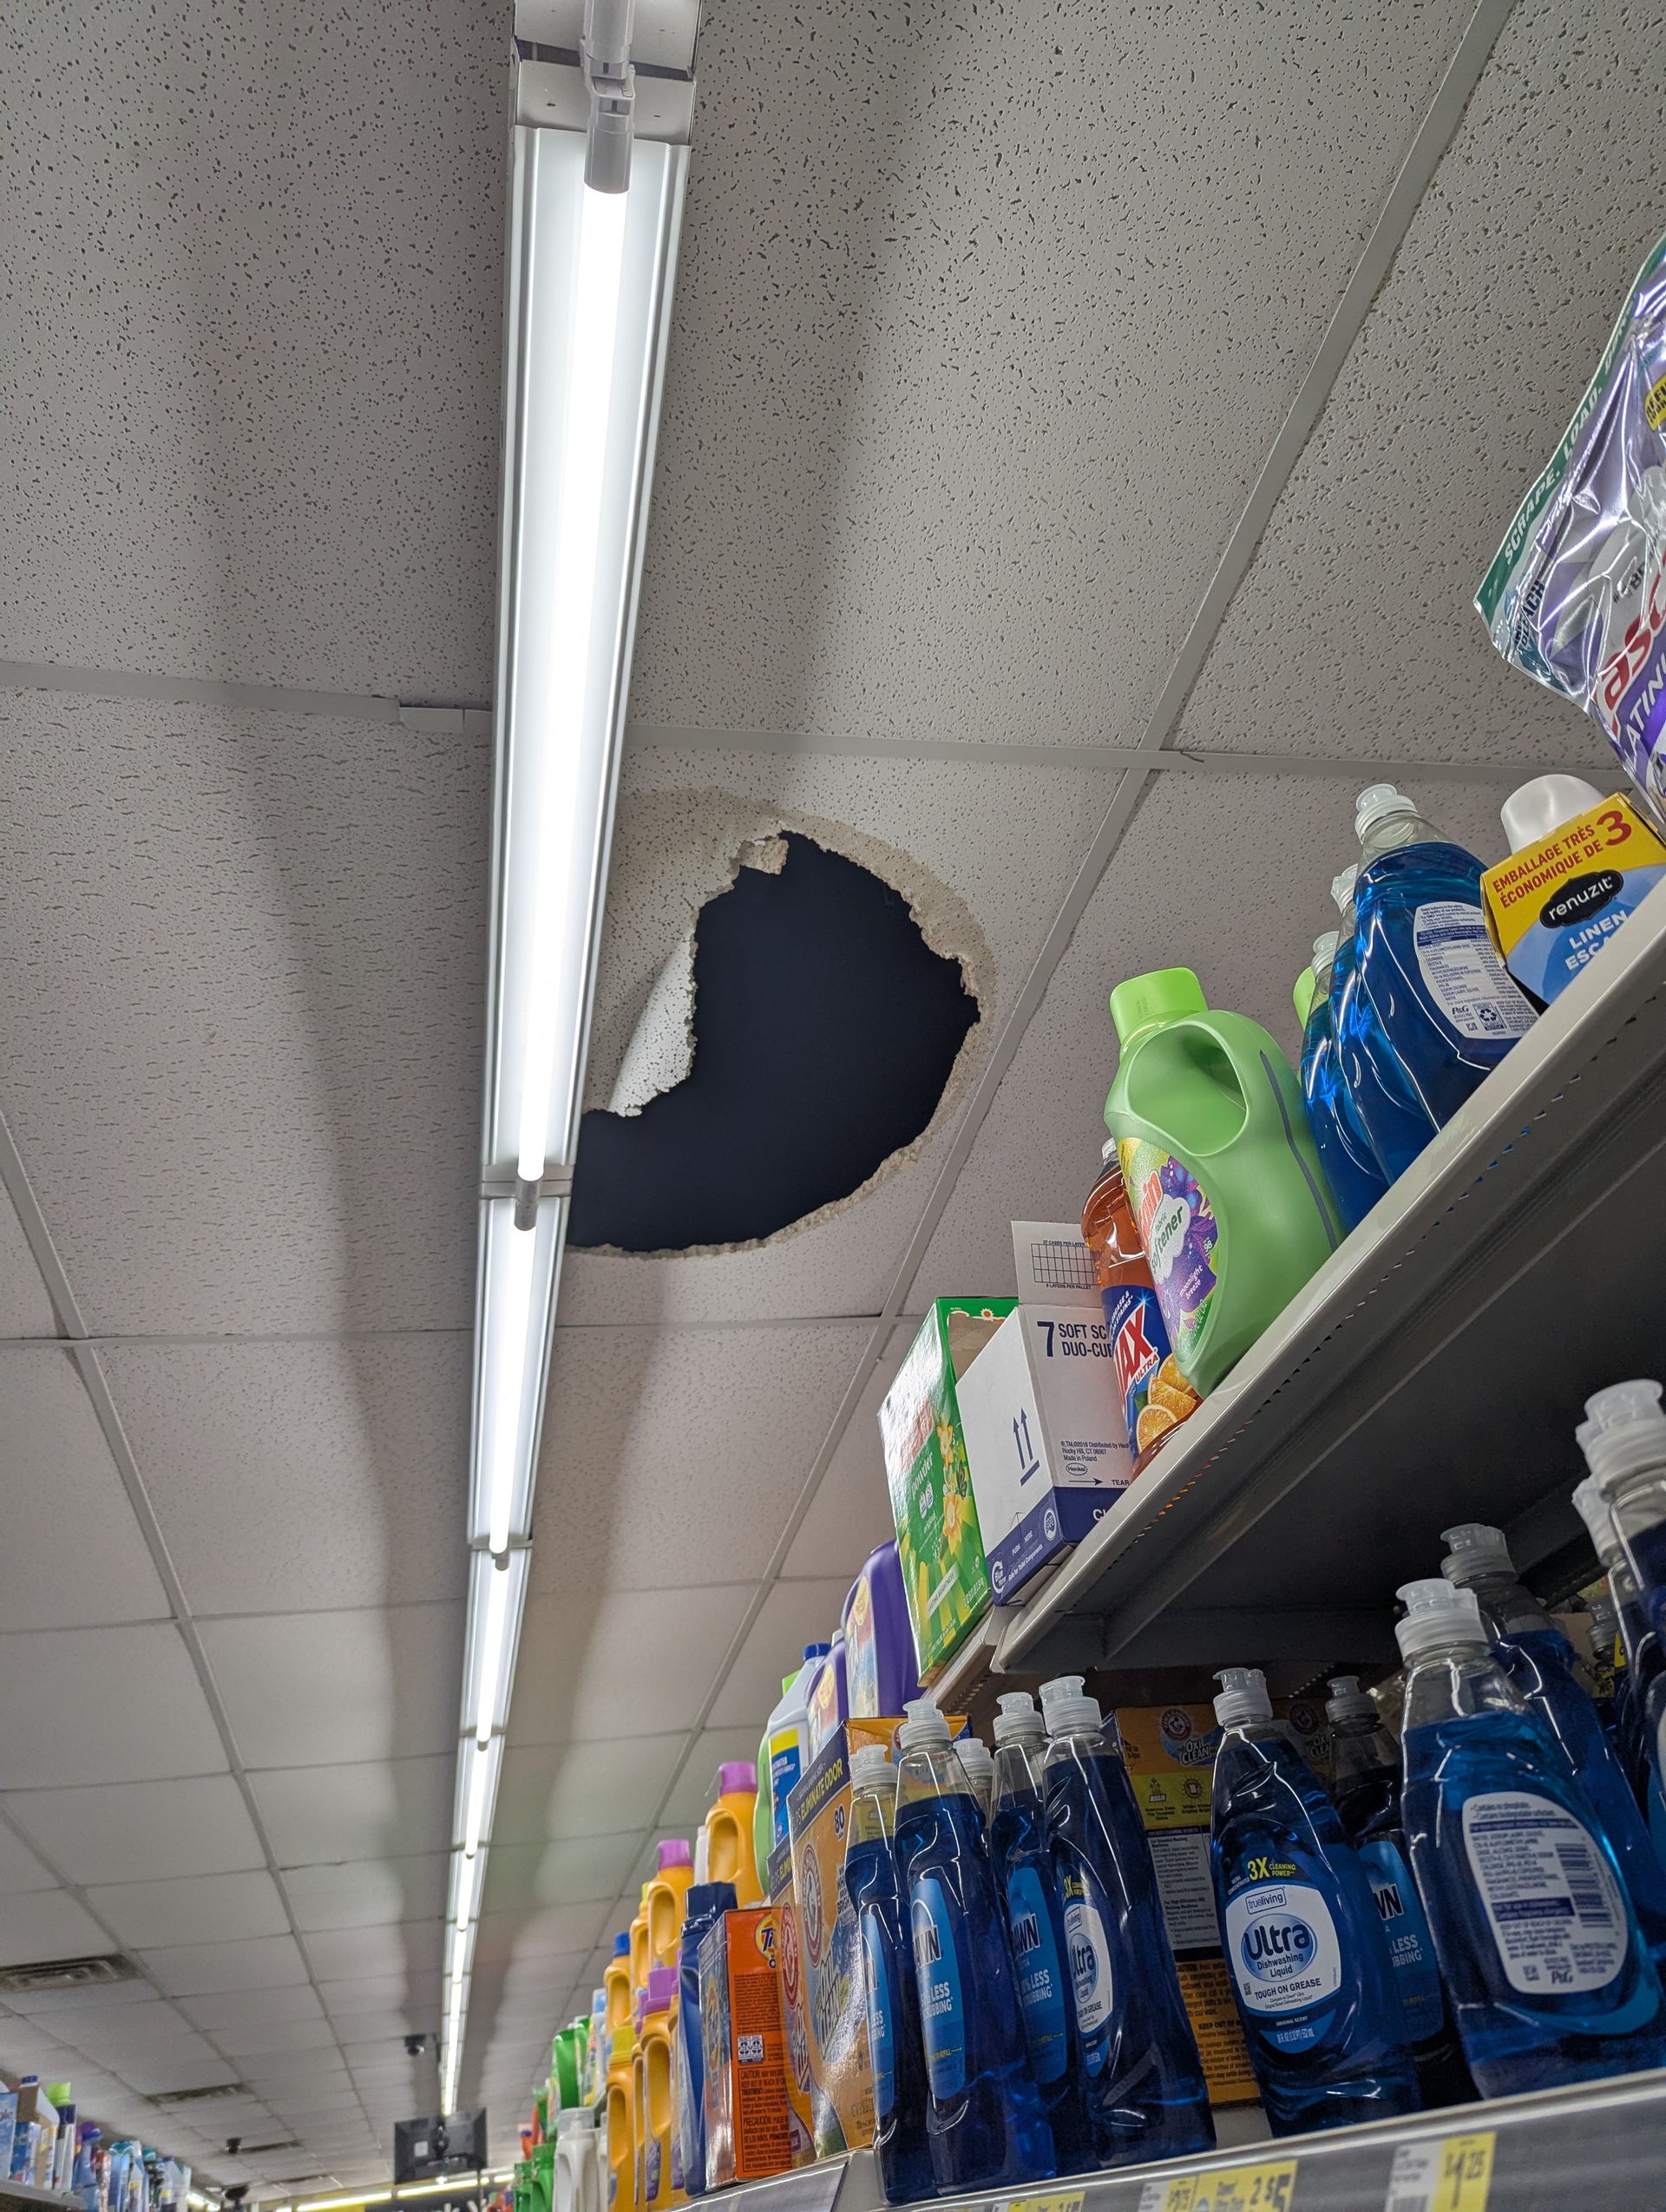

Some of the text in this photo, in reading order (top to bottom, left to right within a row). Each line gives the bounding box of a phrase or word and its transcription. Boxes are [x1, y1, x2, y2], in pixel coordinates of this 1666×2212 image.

[1505, 387, 1603, 565] SCRAPE. LOAD.
[1492, 810, 1632, 893] EMBALLAGE TRÈS 3
[1499, 840, 1604, 908] ÉCONOMIQUE DE
[1549, 875, 1613, 920] renuzit
[1569, 910, 1628, 949] LINEN
[1452, 1005, 1469, 1015] P&G
[1151, 1206, 1184, 1274] softener
[1179, 1265, 1204, 1299] moonlight
[1185, 1279, 1202, 1299] breeze
[1037, 1321, 1055, 1357] 7
[1059, 1323, 1088, 1339] SOFT
[1135, 1353, 1159, 1384] ULTRA
[911, 1451, 934, 1502] powder
[1181, 1746, 1210, 1764] CLEAN
[800, 1777, 825, 1821] ELIMINATE
[825, 1757, 844, 1790] ODOR
[834, 1803, 845, 1834] 80
[1247, 1856, 1270, 1881] 3X
[1248, 1894, 1283, 1909] trueliving
[914, 1925, 942, 1970] AWN
[1013, 1914, 1040, 1954] AWN
[1243, 1924, 1310, 1960] Ultra
[1392, 1934, 1419, 1953] LESS
[1257, 1953, 1304, 1971] Dishwashing
[1269, 1965, 1293, 1978] Liquid
[930, 1981, 950, 2001] LESS
[1031, 1969, 1050, 1988] LESS
[1255, 1978, 1322, 1999] TOUGH ON GREASE
